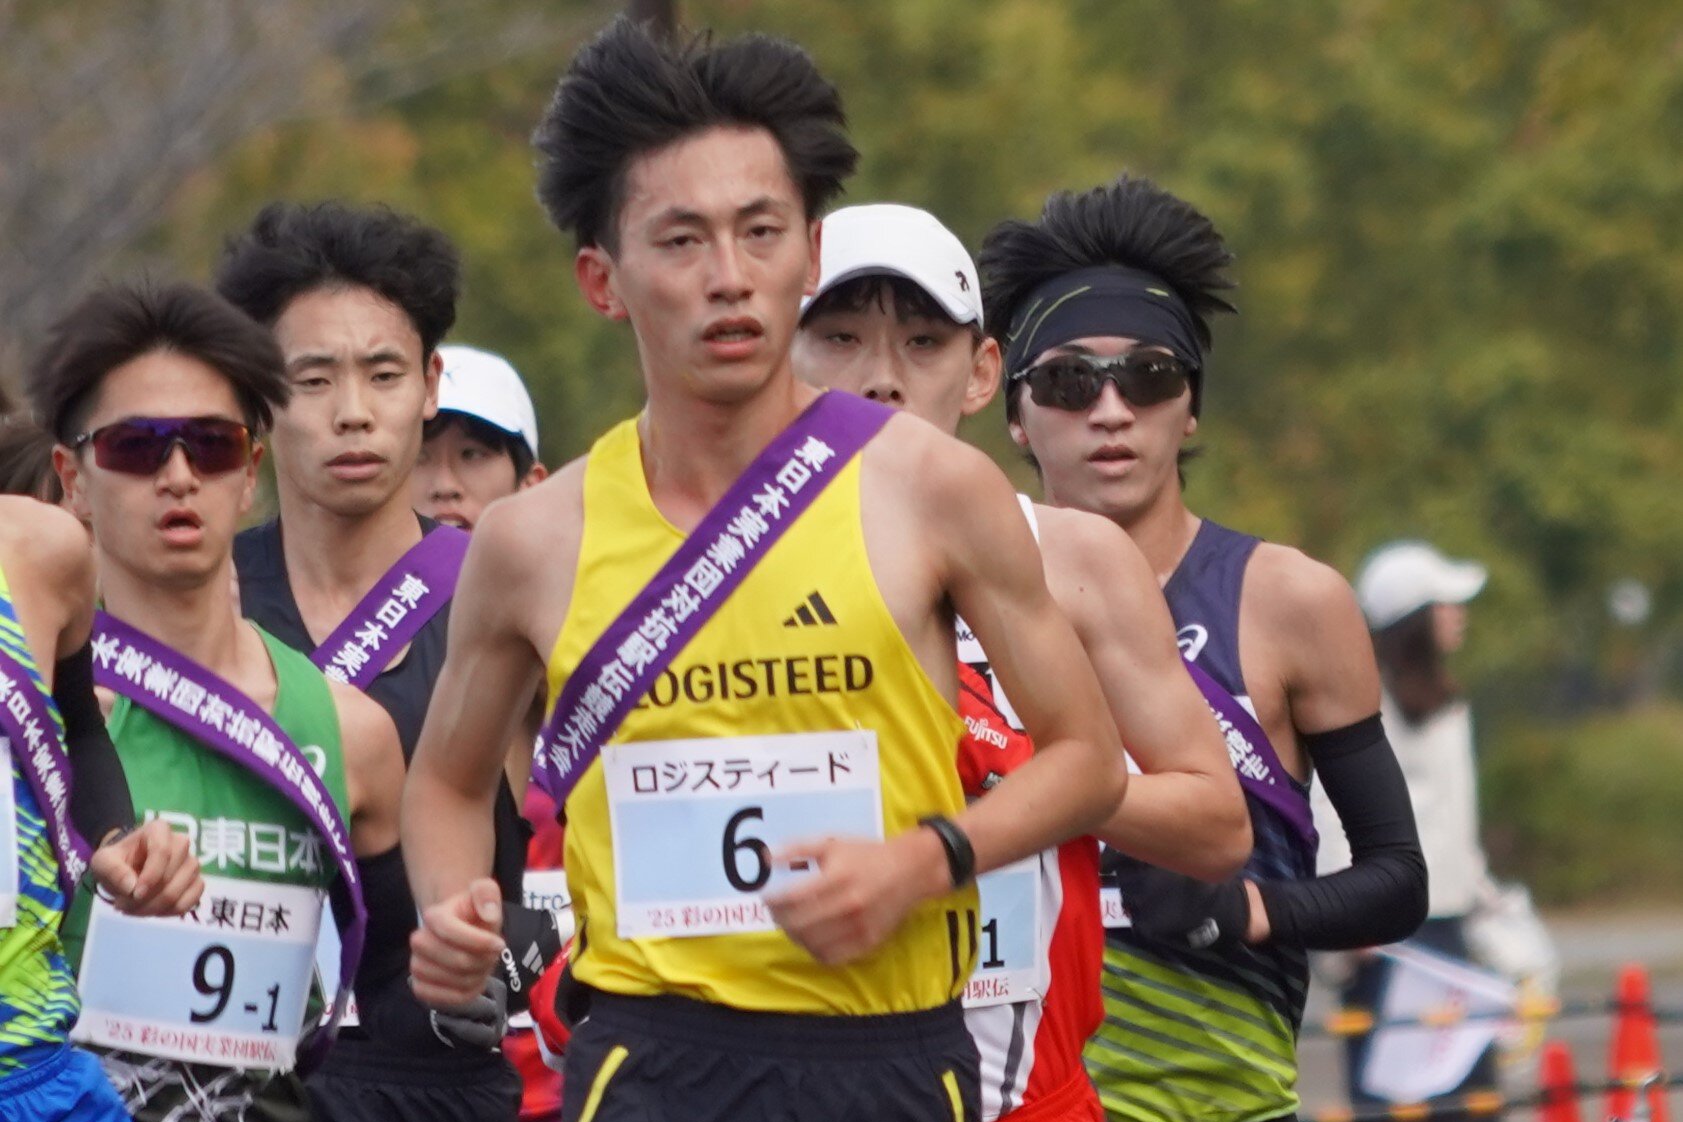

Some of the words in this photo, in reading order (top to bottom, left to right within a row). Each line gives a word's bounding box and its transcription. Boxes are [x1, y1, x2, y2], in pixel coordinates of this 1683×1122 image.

[636, 654, 874, 708] OGISTEED
[965, 715, 1008, 750] FUJITSU
[632, 752, 852, 794] ロジスティード
[189, 942, 280, 1033] 9-1
[501, 947, 522, 992] GMO
